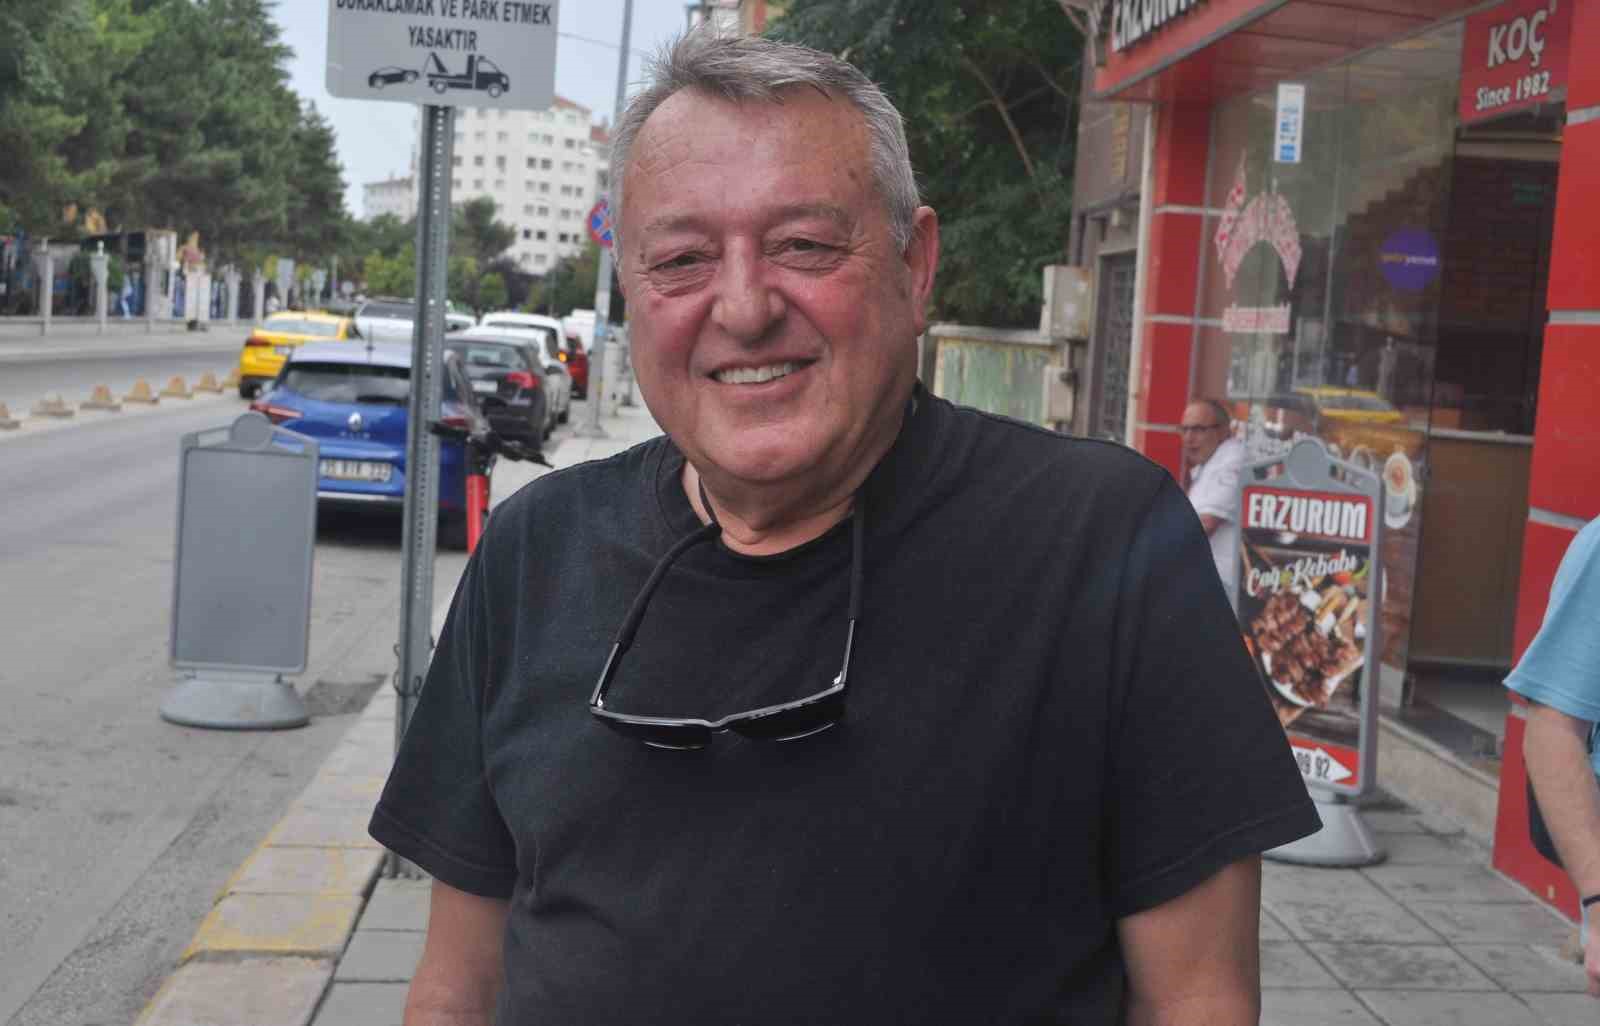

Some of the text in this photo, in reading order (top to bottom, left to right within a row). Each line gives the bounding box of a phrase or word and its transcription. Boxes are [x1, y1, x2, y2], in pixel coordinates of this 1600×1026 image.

[440, 0, 457, 18] VE
[461, 0, 498, 21] PARK
[503, 2, 551, 24] ETMEK
[408, 25, 478, 51] YASAKTIR
[1487, 9, 1548, 69] KOÇ
[1475, 70, 1550, 110] Since 1982
[1247, 492, 1367, 539] ERZURUM
